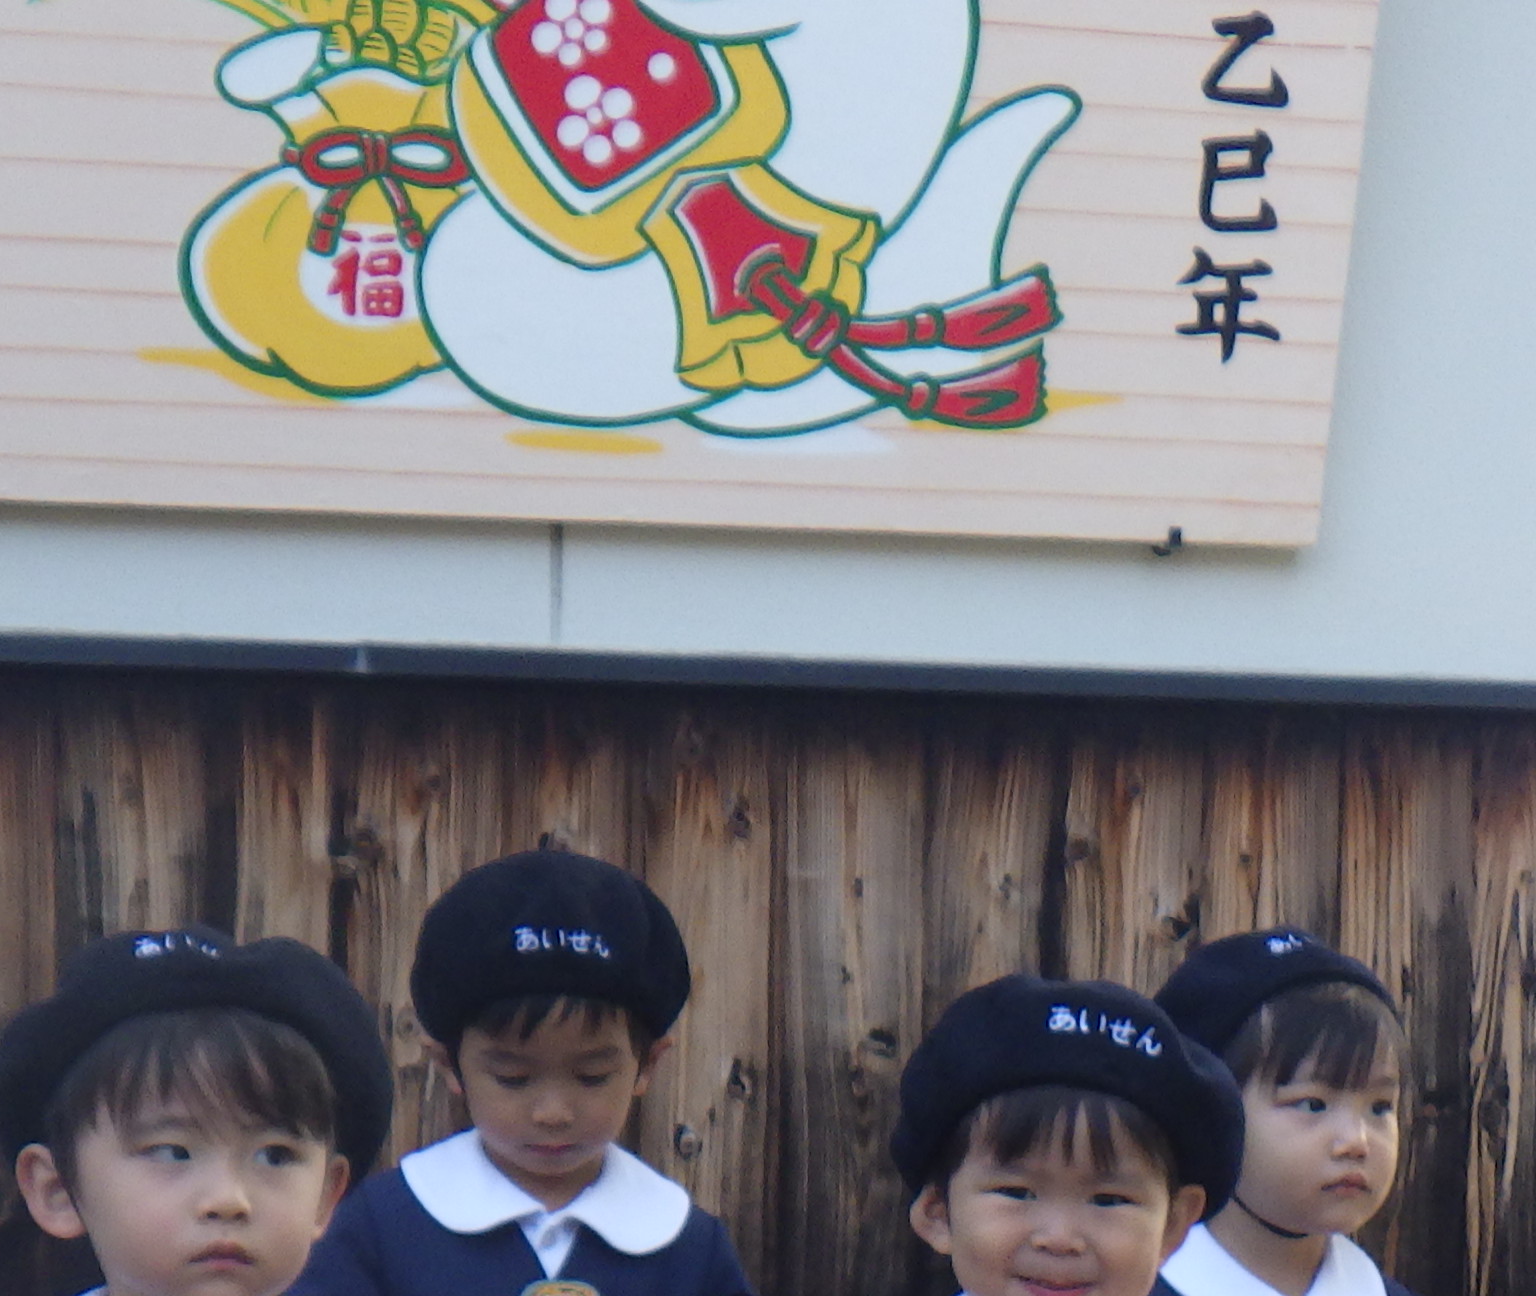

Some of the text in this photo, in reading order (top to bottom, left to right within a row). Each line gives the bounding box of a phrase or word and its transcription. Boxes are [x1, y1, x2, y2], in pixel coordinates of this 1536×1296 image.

[1174, 10, 1290, 365] 乙巳年
[327, 229, 404, 318] 福
[514, 926, 612, 959] あいせん
[1047, 1005, 1164, 1057] あいせん
